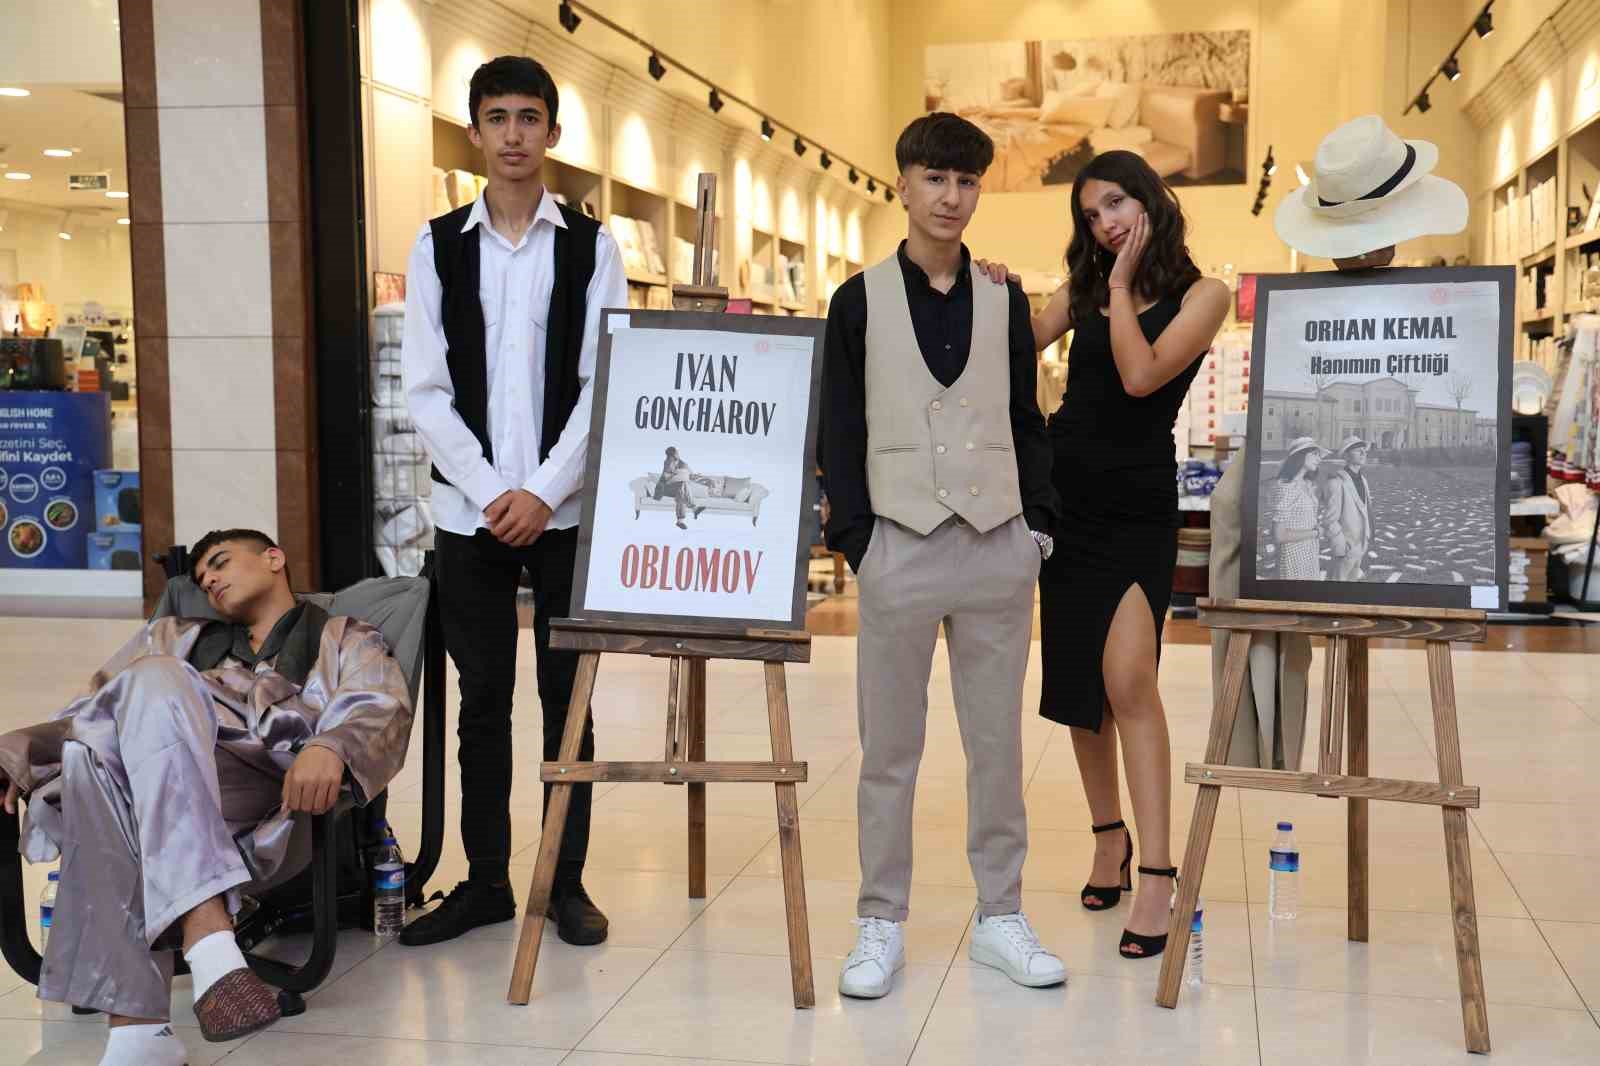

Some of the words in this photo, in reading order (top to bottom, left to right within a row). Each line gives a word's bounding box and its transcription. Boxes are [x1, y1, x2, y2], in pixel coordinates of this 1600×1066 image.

[1304, 318, 1376, 342] ORHAN
[1383, 316, 1457, 340] KEMAL
[674, 352, 738, 392] IVAN
[1310, 355, 1381, 375] Hanımın
[1386, 353, 1449, 376] Çiftliği
[26, 408, 54, 417] HOME
[634, 395, 777, 437] GONCHAROV
[23, 450, 73, 464] Kaydet
[620, 543, 764, 595] OBLOMOV
